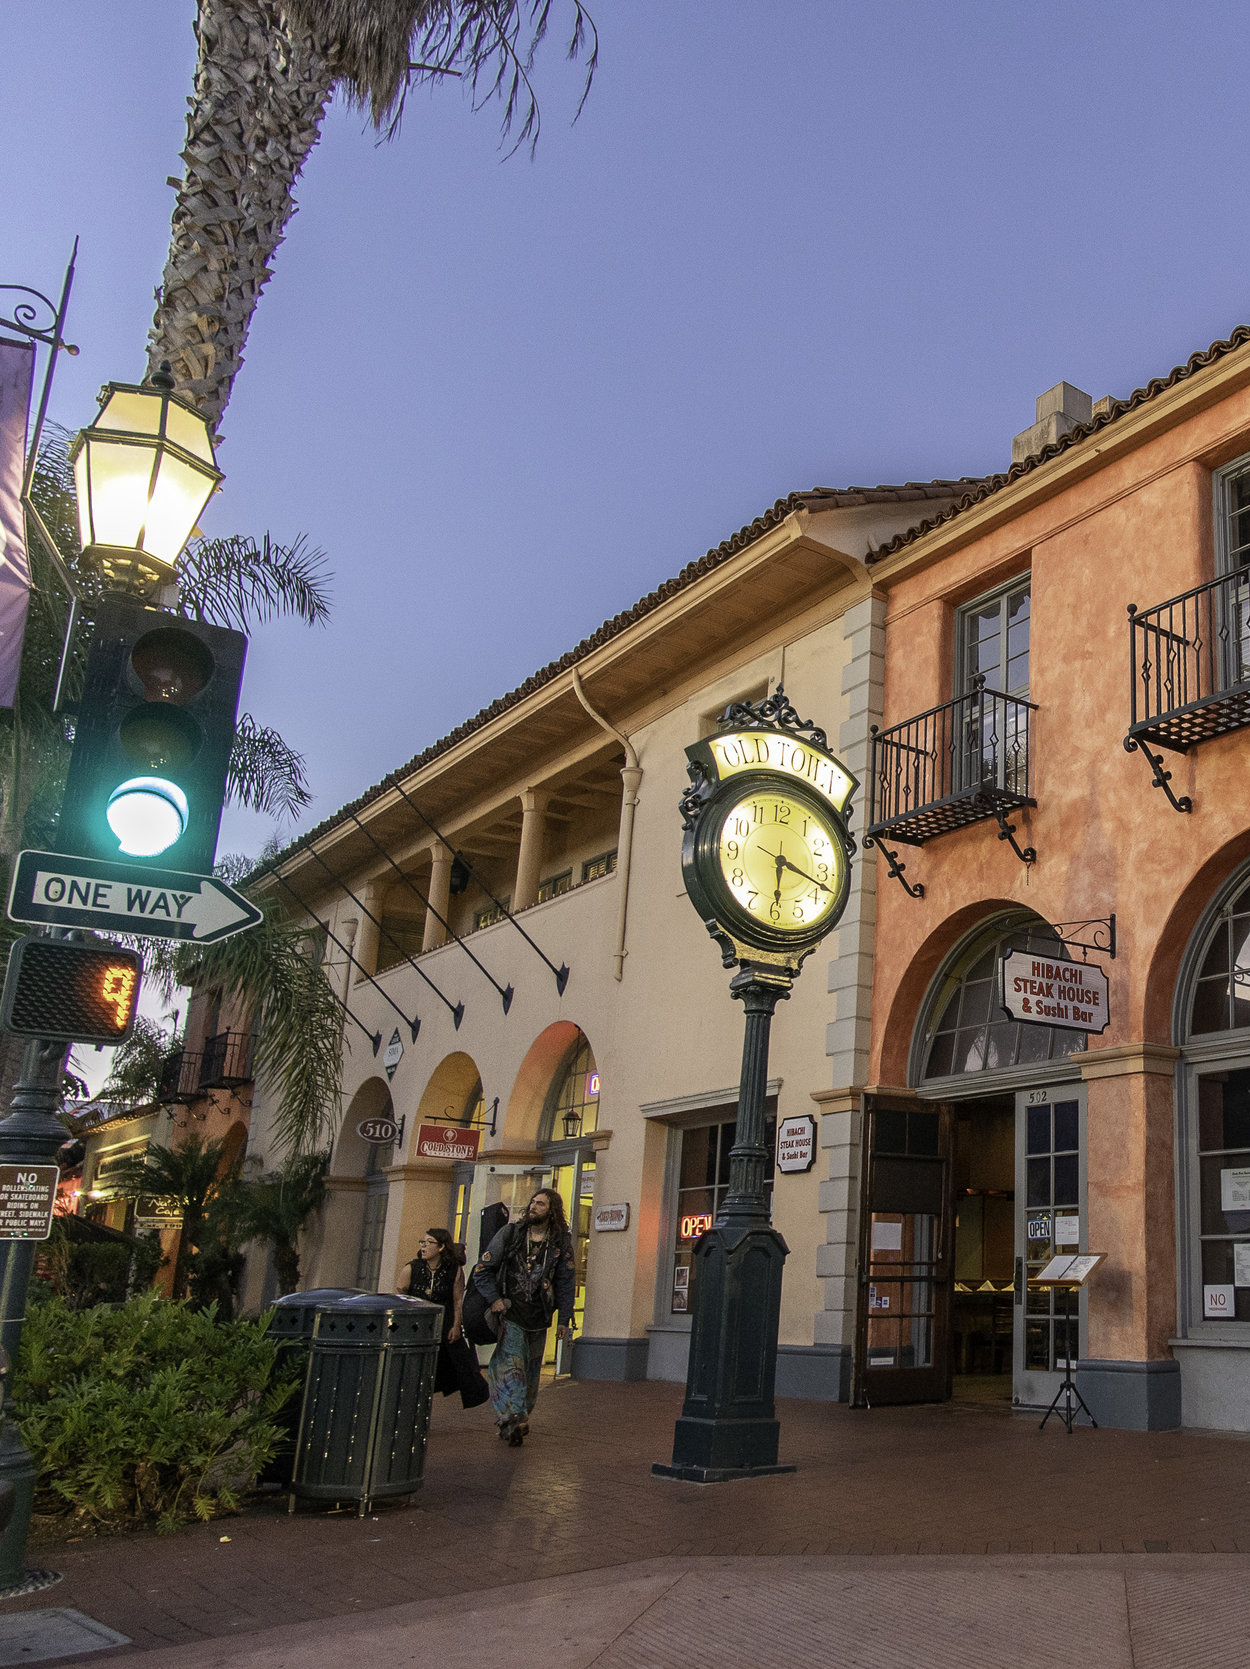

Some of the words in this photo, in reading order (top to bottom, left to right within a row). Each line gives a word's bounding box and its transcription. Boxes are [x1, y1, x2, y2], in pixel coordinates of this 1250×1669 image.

[723, 738, 769, 768] OLD
[777, 741, 842, 794] TOWN
[753, 804, 763, 824] 11
[773, 804, 791, 824] 12
[735, 818, 749, 837] 10
[802, 820, 807, 837] 1
[727, 840, 739, 860] 9
[813, 838, 824, 857] 2
[731, 868, 743, 887] 8
[816, 863, 828, 882] 3
[44, 877, 112, 910] ONE
[126, 887, 193, 918] WAY
[747, 890, 759, 910] 7
[807, 887, 821, 905] 4
[769, 901, 781, 920] 6
[792, 899, 803, 918] 5
[1032, 961, 1082, 985] HIBACHI
[102, 965, 136, 1029] 9
[1014, 977, 1054, 999] STEAK
[1058, 985, 1099, 1006] HOUSE
[1022, 997, 1032, 1014] &
[1036, 1000, 1068, 1019] Sushi
[1073, 1006, 1093, 1023] Bar
[1029, 1091, 1047, 1103] 502
[363, 1123, 392, 1139] 510
[787, 1127, 805, 1136] HIBACHI
[421, 1141, 444, 1153] COLD
[445, 1144, 474, 1157] STONE
[780, 1140, 794, 1149] STEAK
[796, 1138, 811, 1147] HOUSE
[786, 1151, 798, 1160] Sushi
[17, 1173, 37, 1183] NO
[682, 1216, 711, 1236] OPEN
[1030, 1221, 1050, 1237] OPEN
[1210, 1293, 1226, 1306] NO
